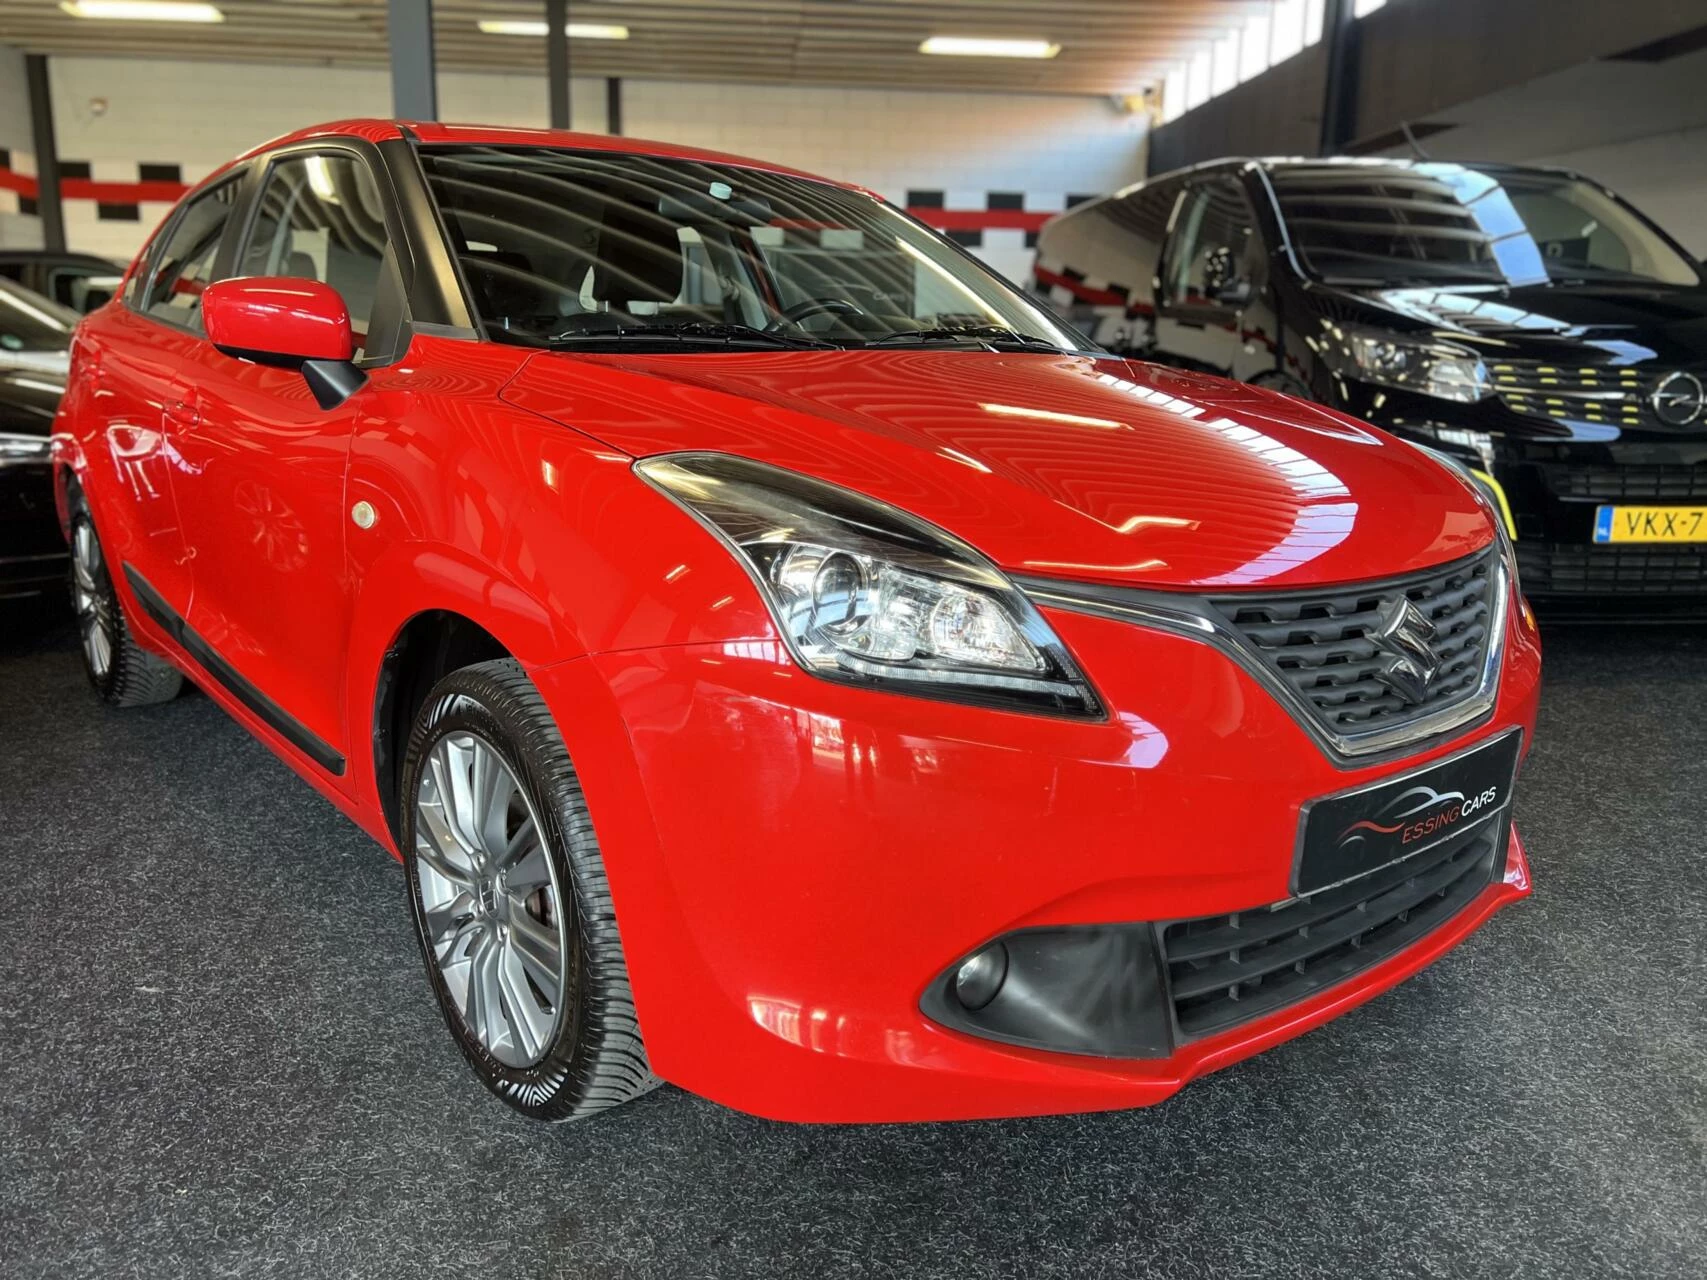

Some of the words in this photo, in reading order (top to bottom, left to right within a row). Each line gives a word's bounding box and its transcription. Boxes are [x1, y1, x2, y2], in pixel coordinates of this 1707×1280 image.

[1626, 512, 1704, 537] VKX-7
[1402, 806, 1460, 844] ESSING
[1461, 786, 1497, 817] CARS
